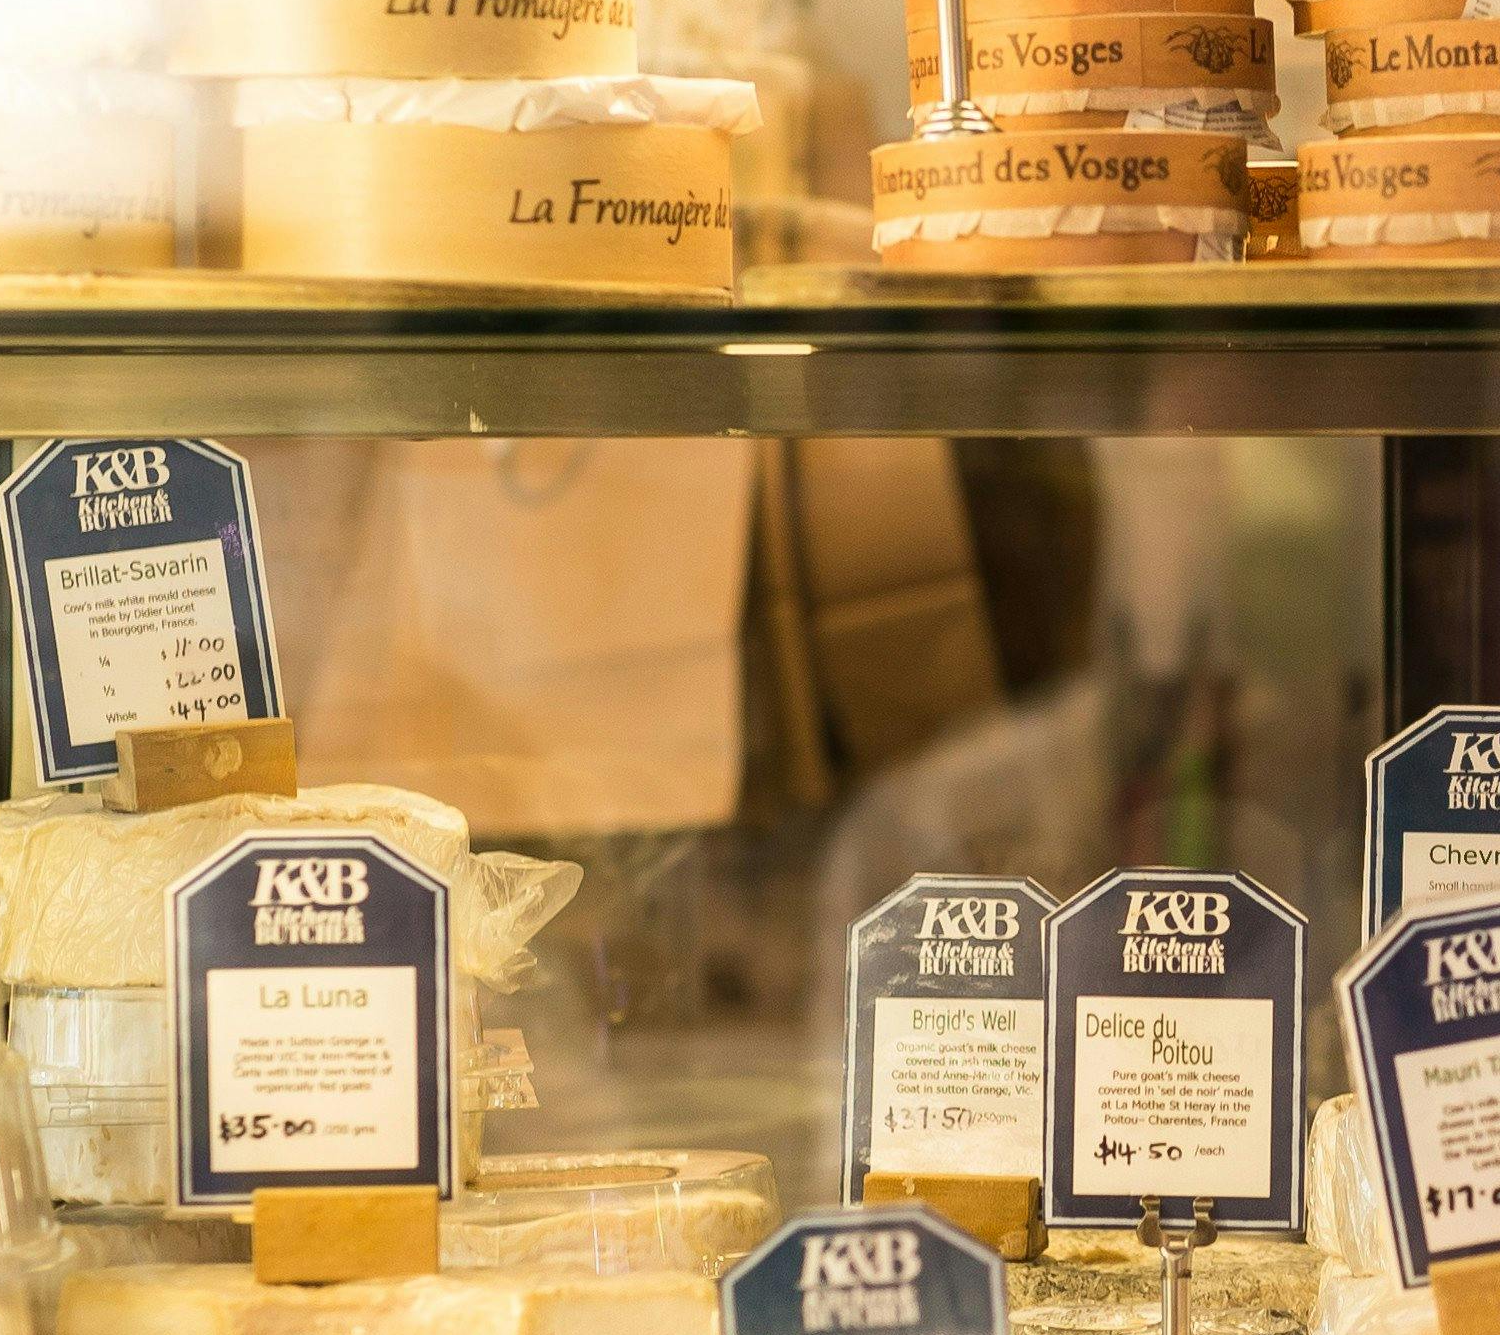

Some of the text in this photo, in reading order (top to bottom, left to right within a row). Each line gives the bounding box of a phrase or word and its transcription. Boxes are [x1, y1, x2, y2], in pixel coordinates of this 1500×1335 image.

[1007, 33, 1123, 75] Vosges
[1368, 38, 1401, 74] Le
[994, 142, 1170, 189] des Vosges
[508, 177, 711, 246] La Fromagère
[69, 445, 171, 499] K&B
[60, 553, 209, 591] Brillat-Savarin
[106, 710, 138, 725] Whole
[249, 857, 370, 907] K&B
[914, 896, 1021, 940] K&B
[1118, 889, 1232, 937] K&B
[259, 983, 369, 1010] La Luna
[912, 1009, 1017, 1032] Brigid's Well
[1085, 1013, 1178, 1040] Delice du
[1151, 1039, 1214, 1066] Poitou
[1112, 1070, 1240, 1084] Pure goat's milk cheese
[1423, 1056, 1482, 1088] Mauri
